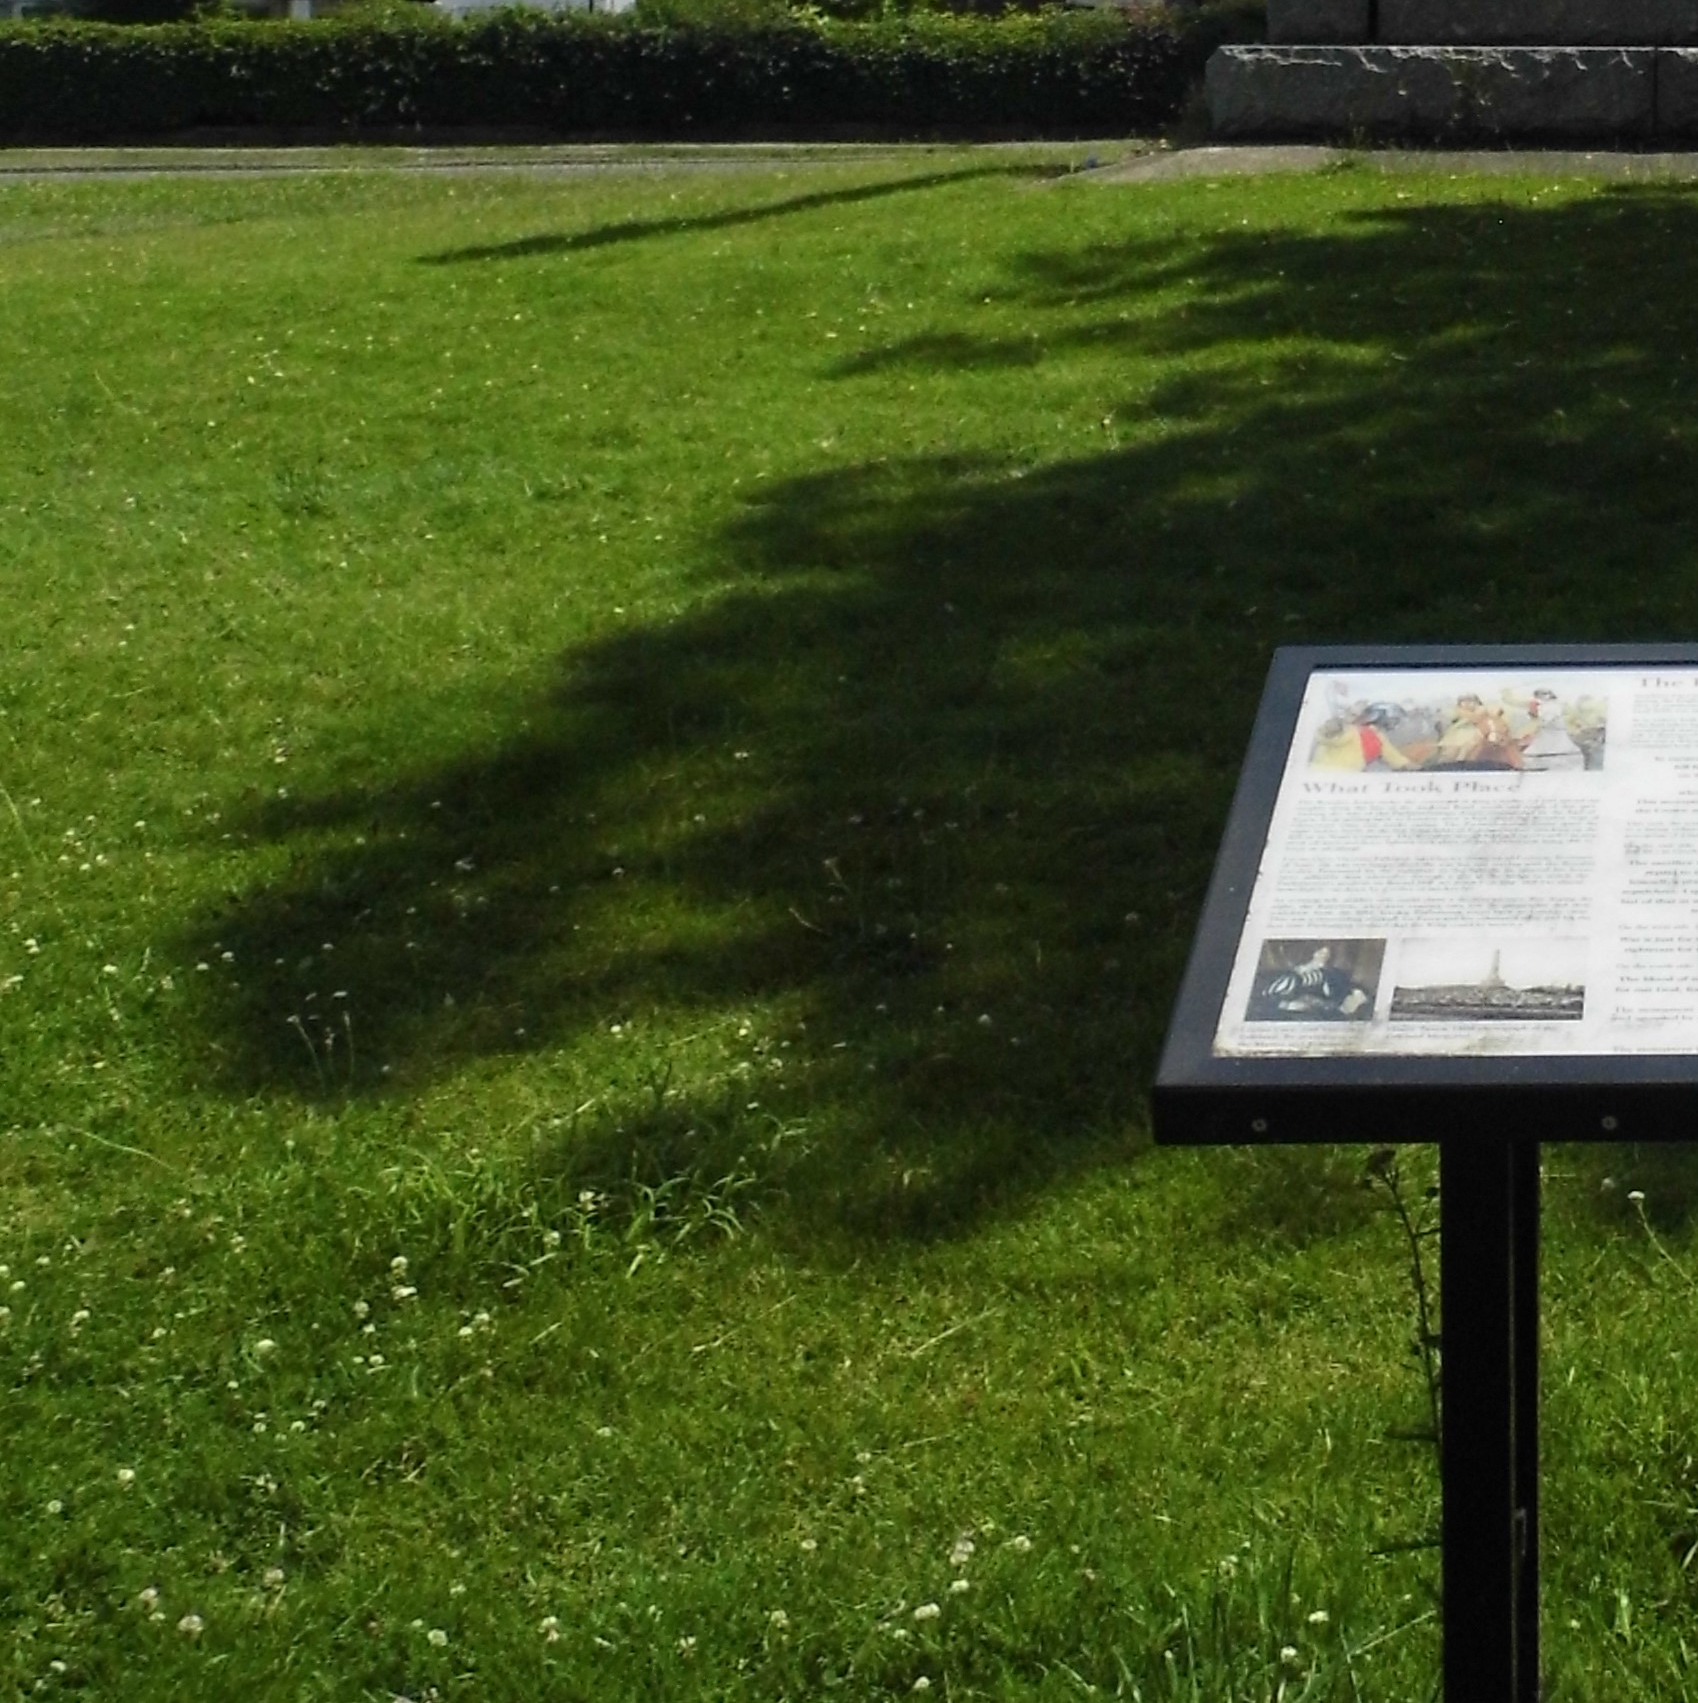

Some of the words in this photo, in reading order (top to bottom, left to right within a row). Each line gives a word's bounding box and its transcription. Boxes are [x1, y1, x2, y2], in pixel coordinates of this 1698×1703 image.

[1638, 676, 1682, 688] The
[1303, 781, 1369, 794] What
[1380, 780, 1442, 794] Took
[1453, 781, 1522, 794] Place
